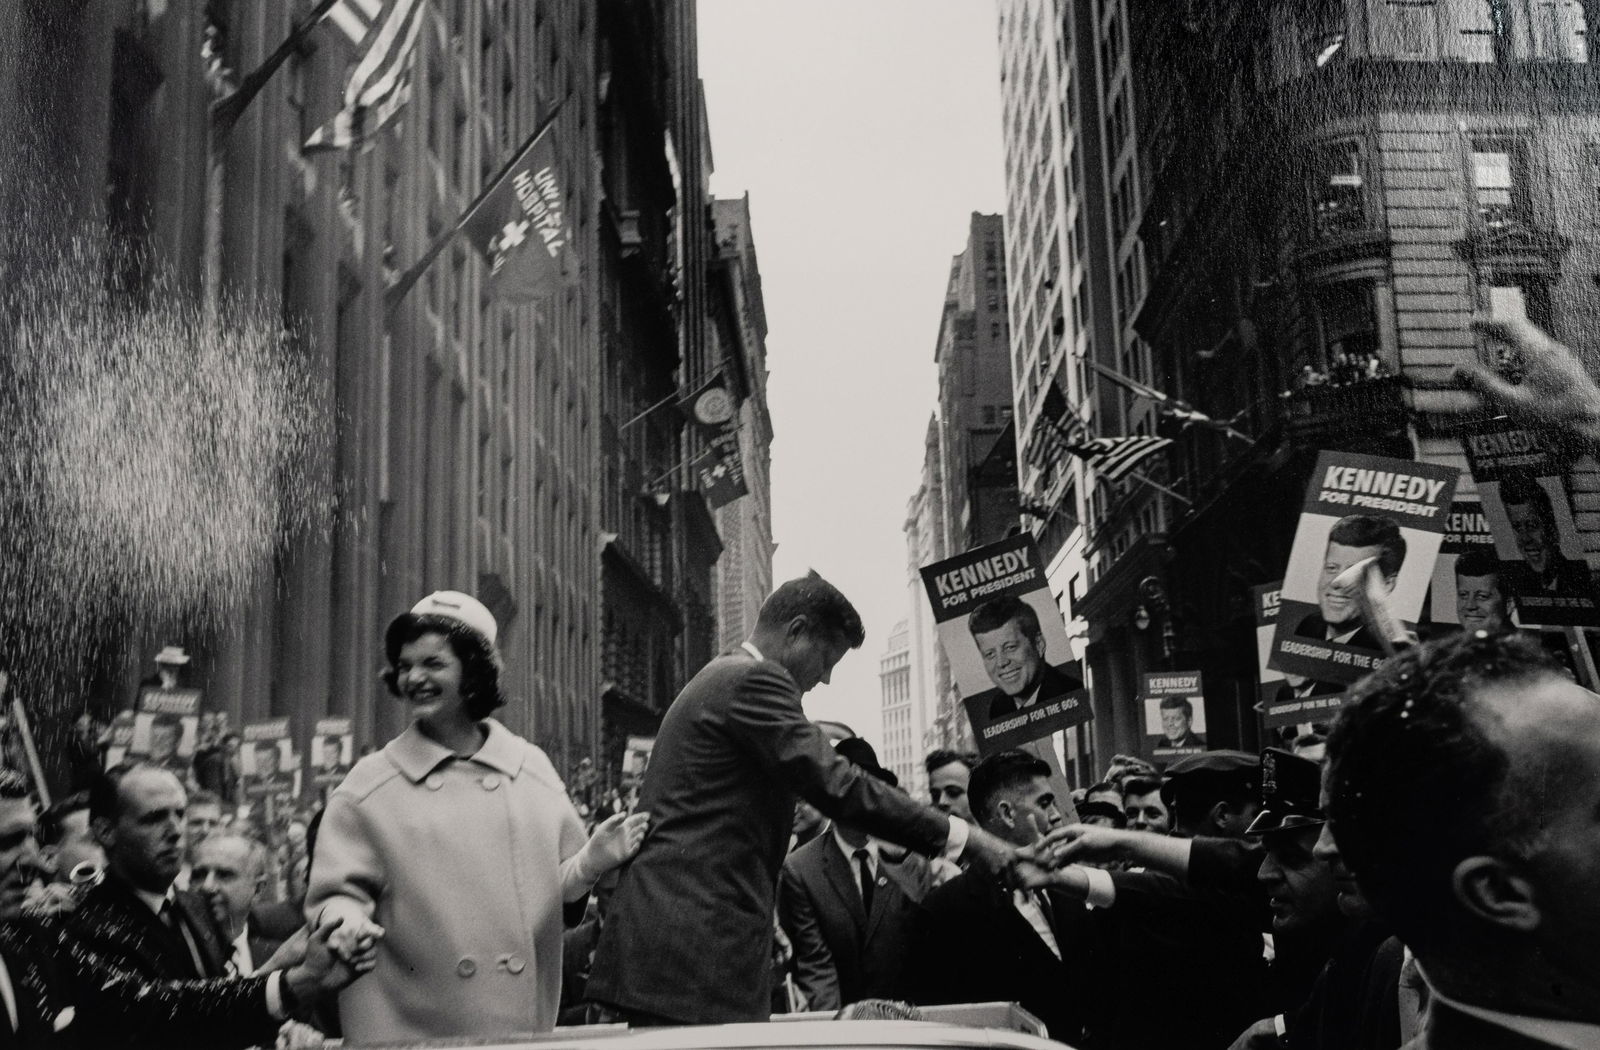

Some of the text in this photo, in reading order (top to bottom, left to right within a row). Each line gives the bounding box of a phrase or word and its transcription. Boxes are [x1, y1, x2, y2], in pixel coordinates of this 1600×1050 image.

[1322, 465, 1447, 503] KENNEDY
[1318, 490, 1440, 518] FOR PRESIDENT
[1445, 534, 1462, 544] OR
[935, 546, 1030, 597] KENNEDY
[941, 567, 1037, 609] FOR PRESIDENT
[1280, 640, 1332, 660] LEADERSHIP
[1333, 650, 1352, 665] FOR
[1352, 653, 1371, 669] THE
[1149, 676, 1197, 689] KENNEDY
[982, 697, 1079, 740] LEADERSHIP FOR THE 60's
